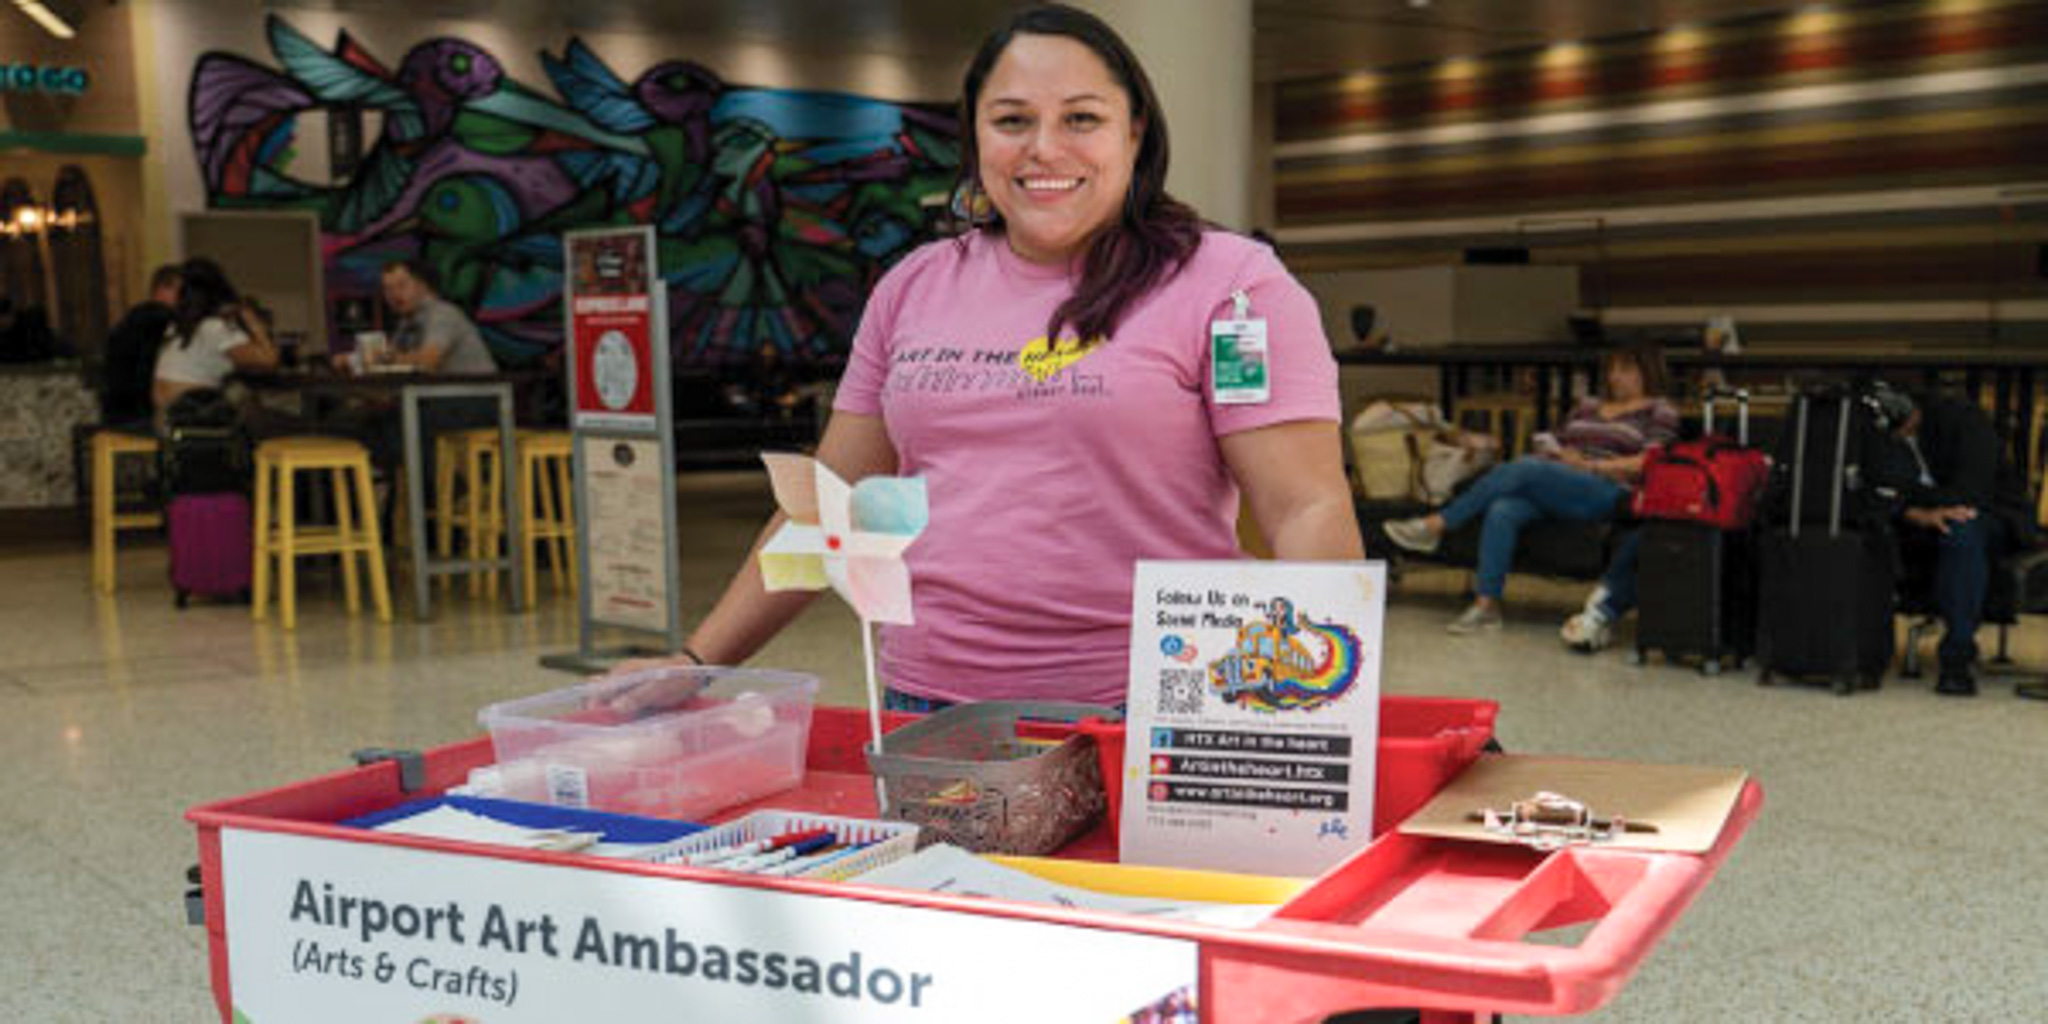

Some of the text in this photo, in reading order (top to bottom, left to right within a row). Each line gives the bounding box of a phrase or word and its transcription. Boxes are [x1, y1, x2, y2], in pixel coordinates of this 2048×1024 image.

[1157, 588, 1250, 607] Follow Us on
[1201, 613, 1244, 628] Media
[1218, 734, 1240, 748] Art
[1243, 736, 1257, 748] in
[1260, 736, 1284, 749] the
[1287, 737, 1330, 752] heart
[290, 878, 933, 1007] Airport Art Ambassador
[292, 939, 519, 1006] (Arts & Crafts)
